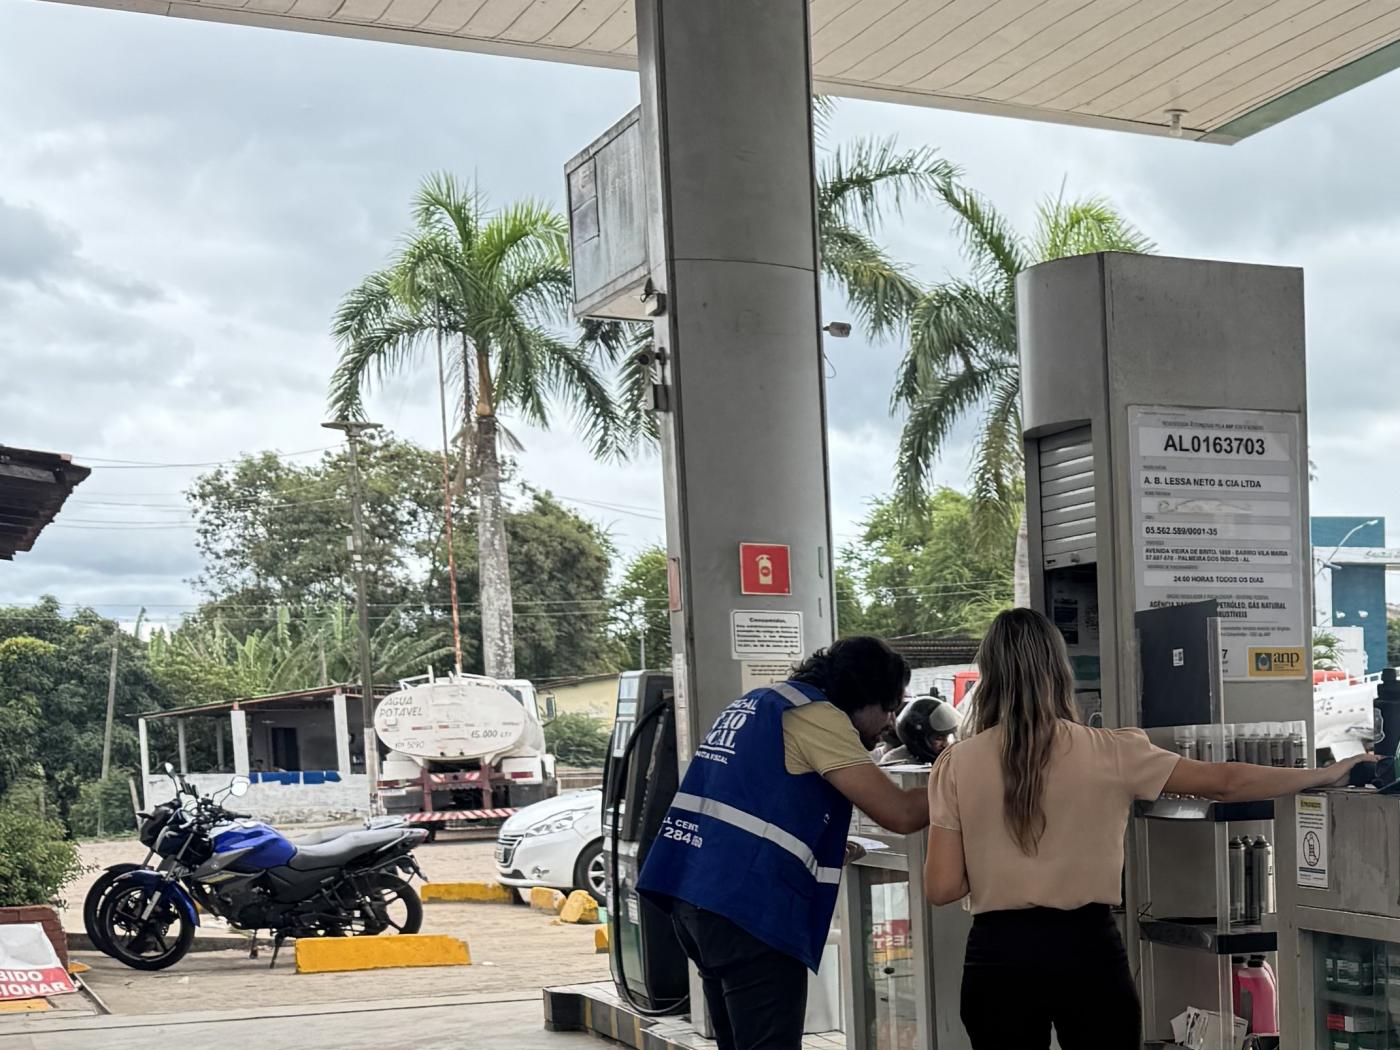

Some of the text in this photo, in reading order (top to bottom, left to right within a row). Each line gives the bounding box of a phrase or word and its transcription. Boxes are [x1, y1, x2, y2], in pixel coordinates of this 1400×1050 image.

[1163, 433, 1266, 456] AL0163703
[1144, 476, 1152, 485] A.
[1154, 477, 1162, 485] B.
[1164, 477, 1192, 486] LESSA
[1193, 478, 1216, 487] NETO
[1225, 479, 1240, 488] CIA
[1240, 479, 1262, 488] LTDA
[0, 982, 68, 996] IONAR
